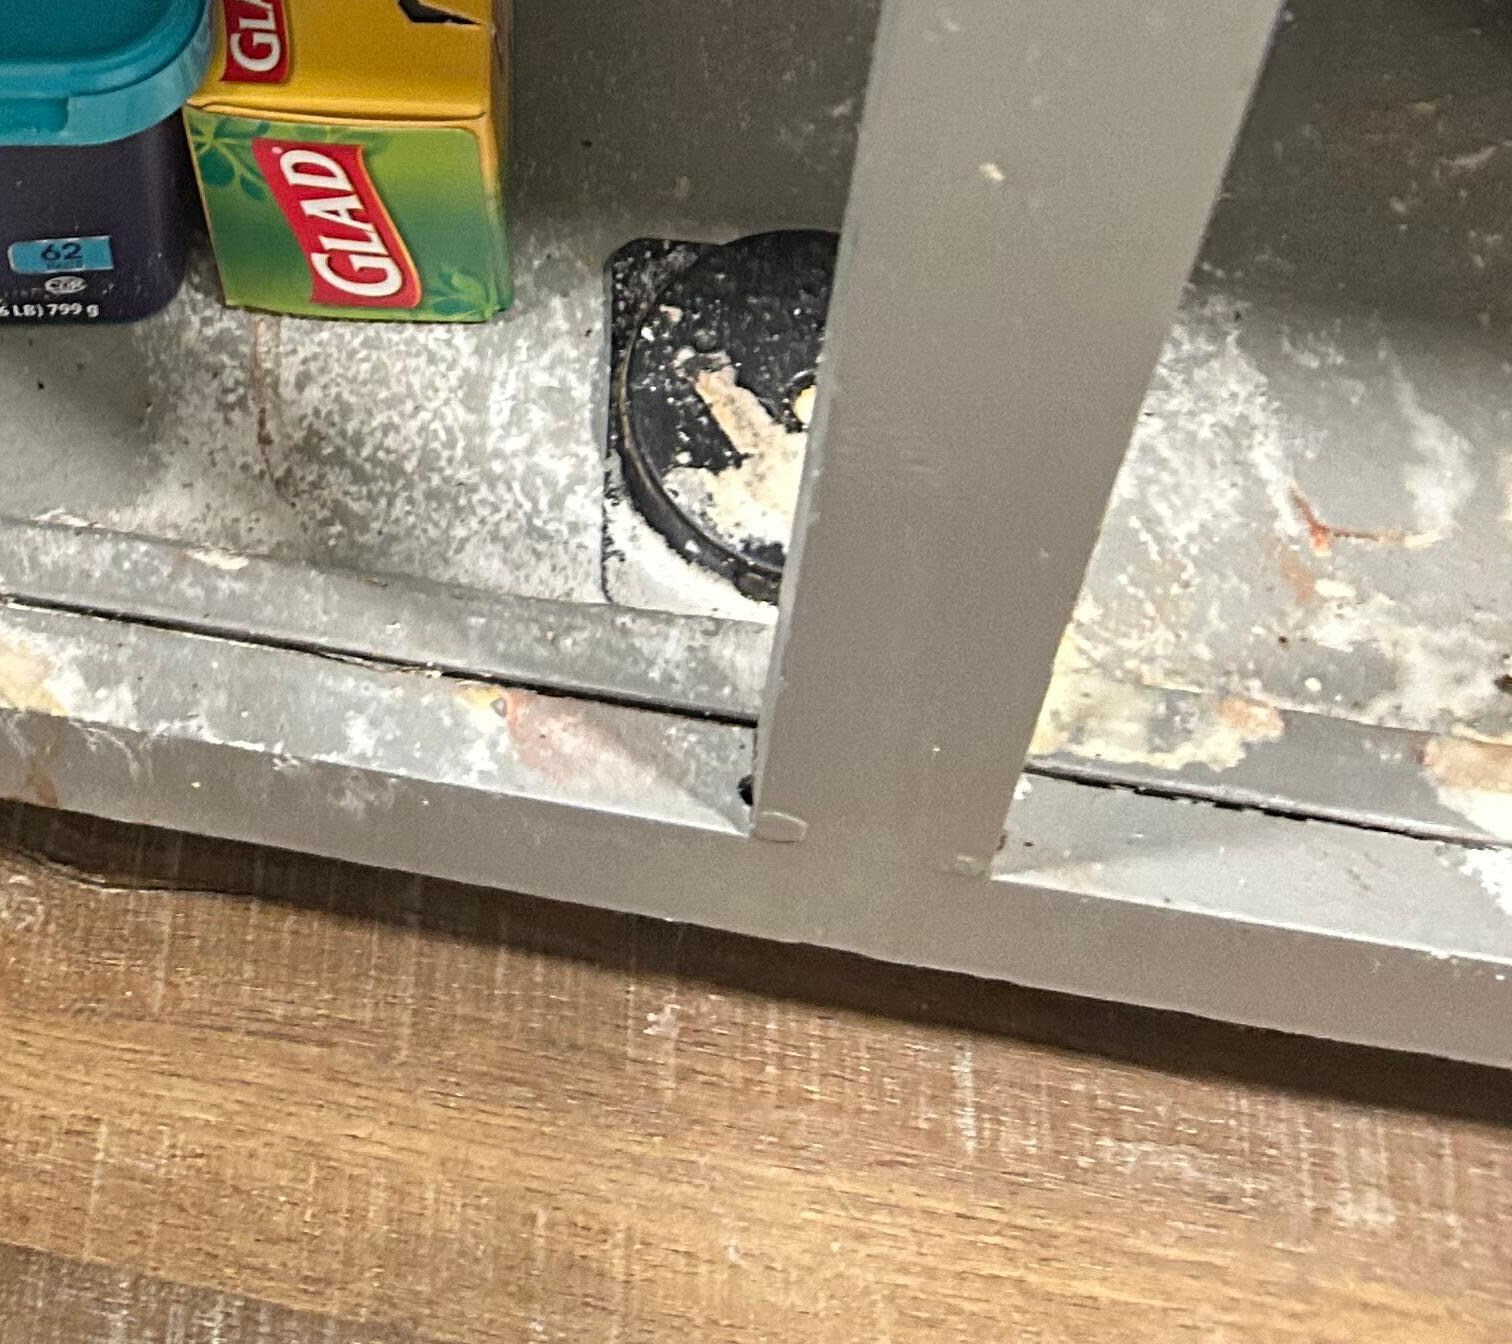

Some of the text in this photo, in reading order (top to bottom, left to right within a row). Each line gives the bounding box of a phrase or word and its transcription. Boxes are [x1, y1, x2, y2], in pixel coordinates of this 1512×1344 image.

[279, 149, 403, 297] GLAD
[40, 242, 83, 262] 62
[12, 304, 45, 318] LB)
[46, 303, 83, 317] 799
[85, 303, 100, 318] g
